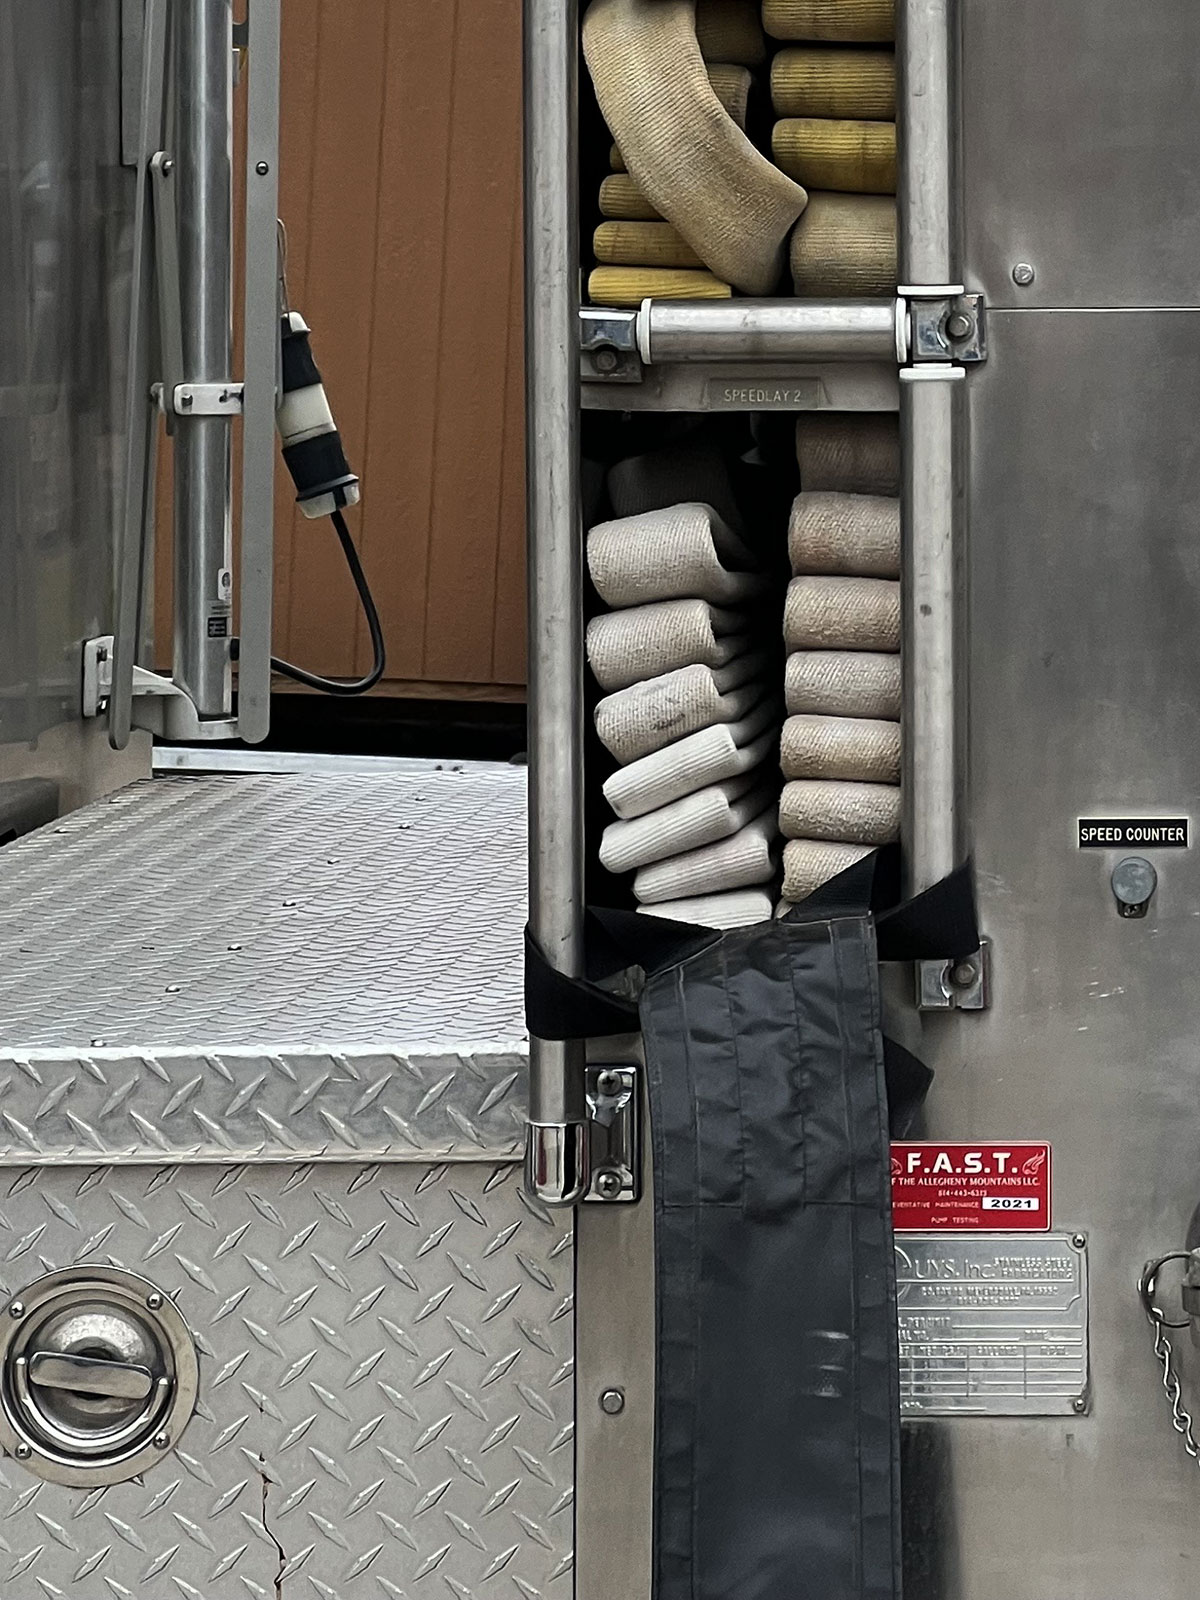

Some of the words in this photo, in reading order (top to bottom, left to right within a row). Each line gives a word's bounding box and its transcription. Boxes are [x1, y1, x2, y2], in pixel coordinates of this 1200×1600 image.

[724, 388, 790, 402] SPEEDLAY
[794, 390, 801, 402] 2
[1081, 827, 1122, 841] SPEED
[1126, 827, 1184, 841] COUNTER
[907, 1152, 1018, 1174] F.A.S.T.
[898, 1177, 916, 1186] THE
[918, 1177, 968, 1186] ALLEGHENY
[970, 1177, 1021, 1186] MOUNTAINS
[892, 1201, 930, 1209] EVENTATIVE
[991, 1199, 1032, 1209] 2021
[952, 1216, 979, 1224] TESTING
